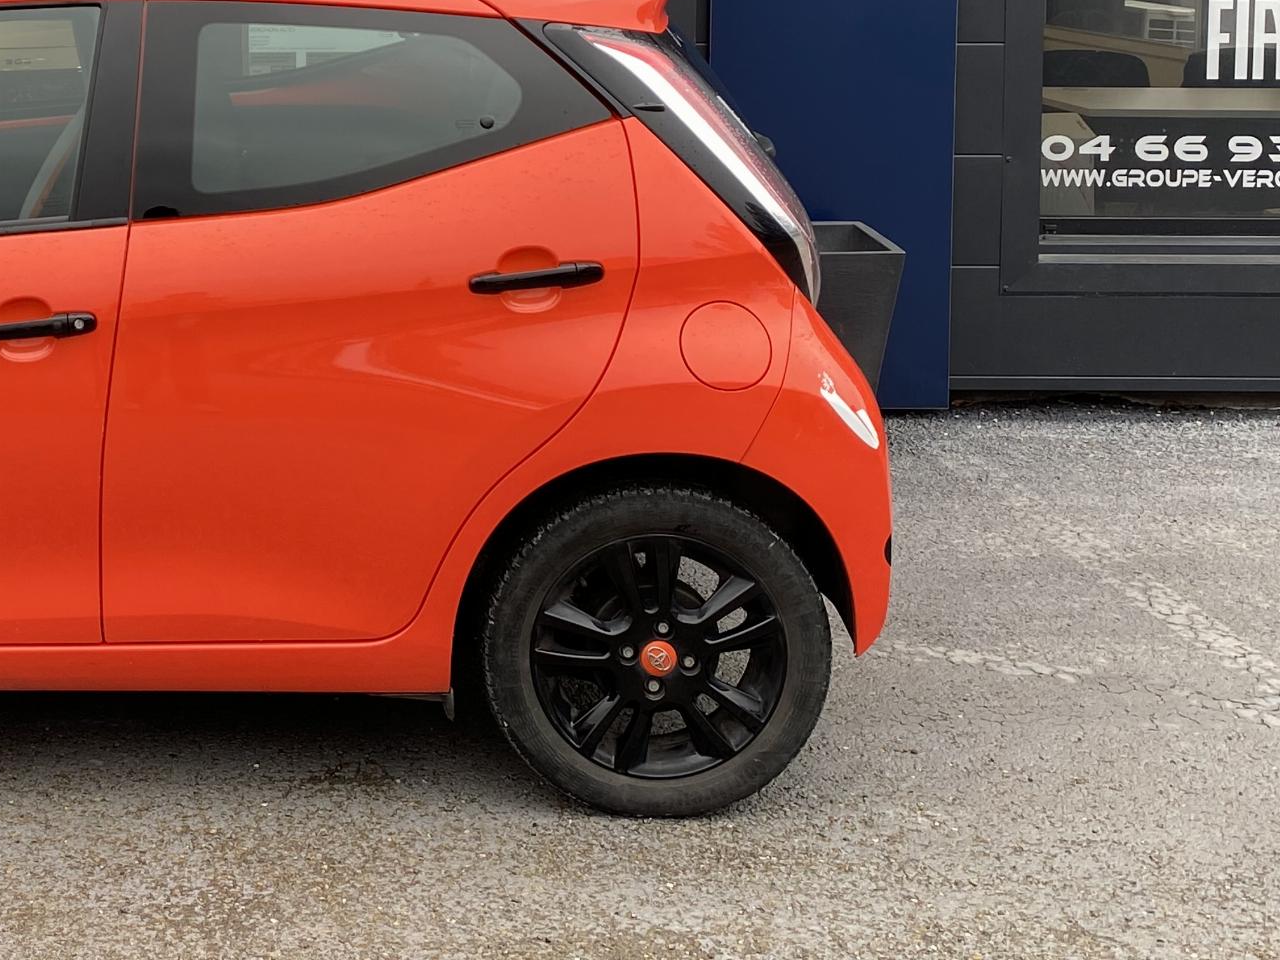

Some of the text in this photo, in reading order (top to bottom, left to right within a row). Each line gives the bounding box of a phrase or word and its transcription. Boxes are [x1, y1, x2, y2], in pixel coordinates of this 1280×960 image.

[1041, 135, 1116, 162] 04
[1135, 135, 1208, 162] 66
[1040, 169, 1280, 188] WWW.GROUPE-VER
